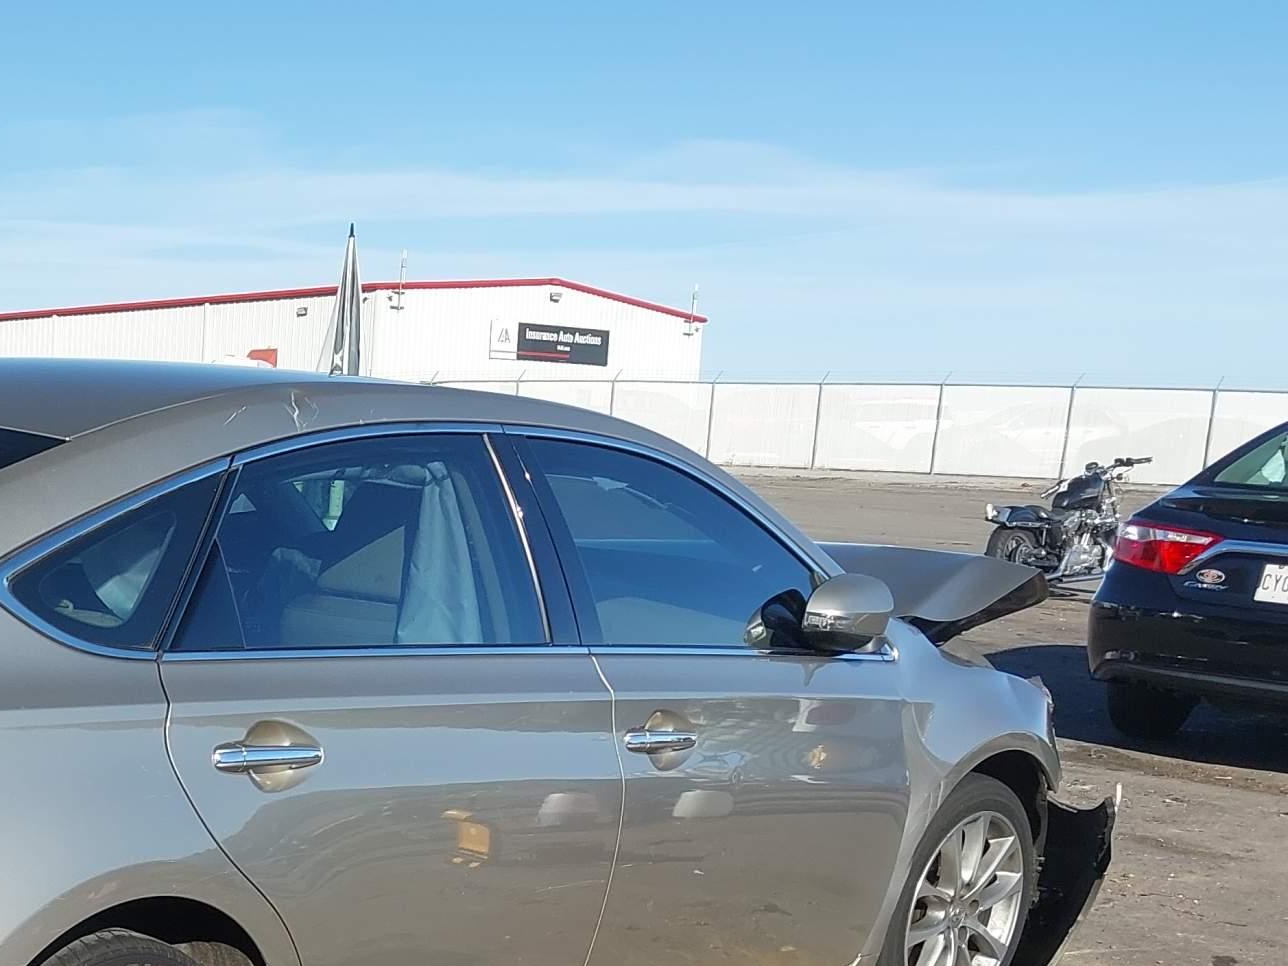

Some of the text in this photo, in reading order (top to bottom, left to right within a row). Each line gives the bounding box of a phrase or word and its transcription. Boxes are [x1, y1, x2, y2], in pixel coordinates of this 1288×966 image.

[525, 328, 602, 345] Insurance Auto Auctions
